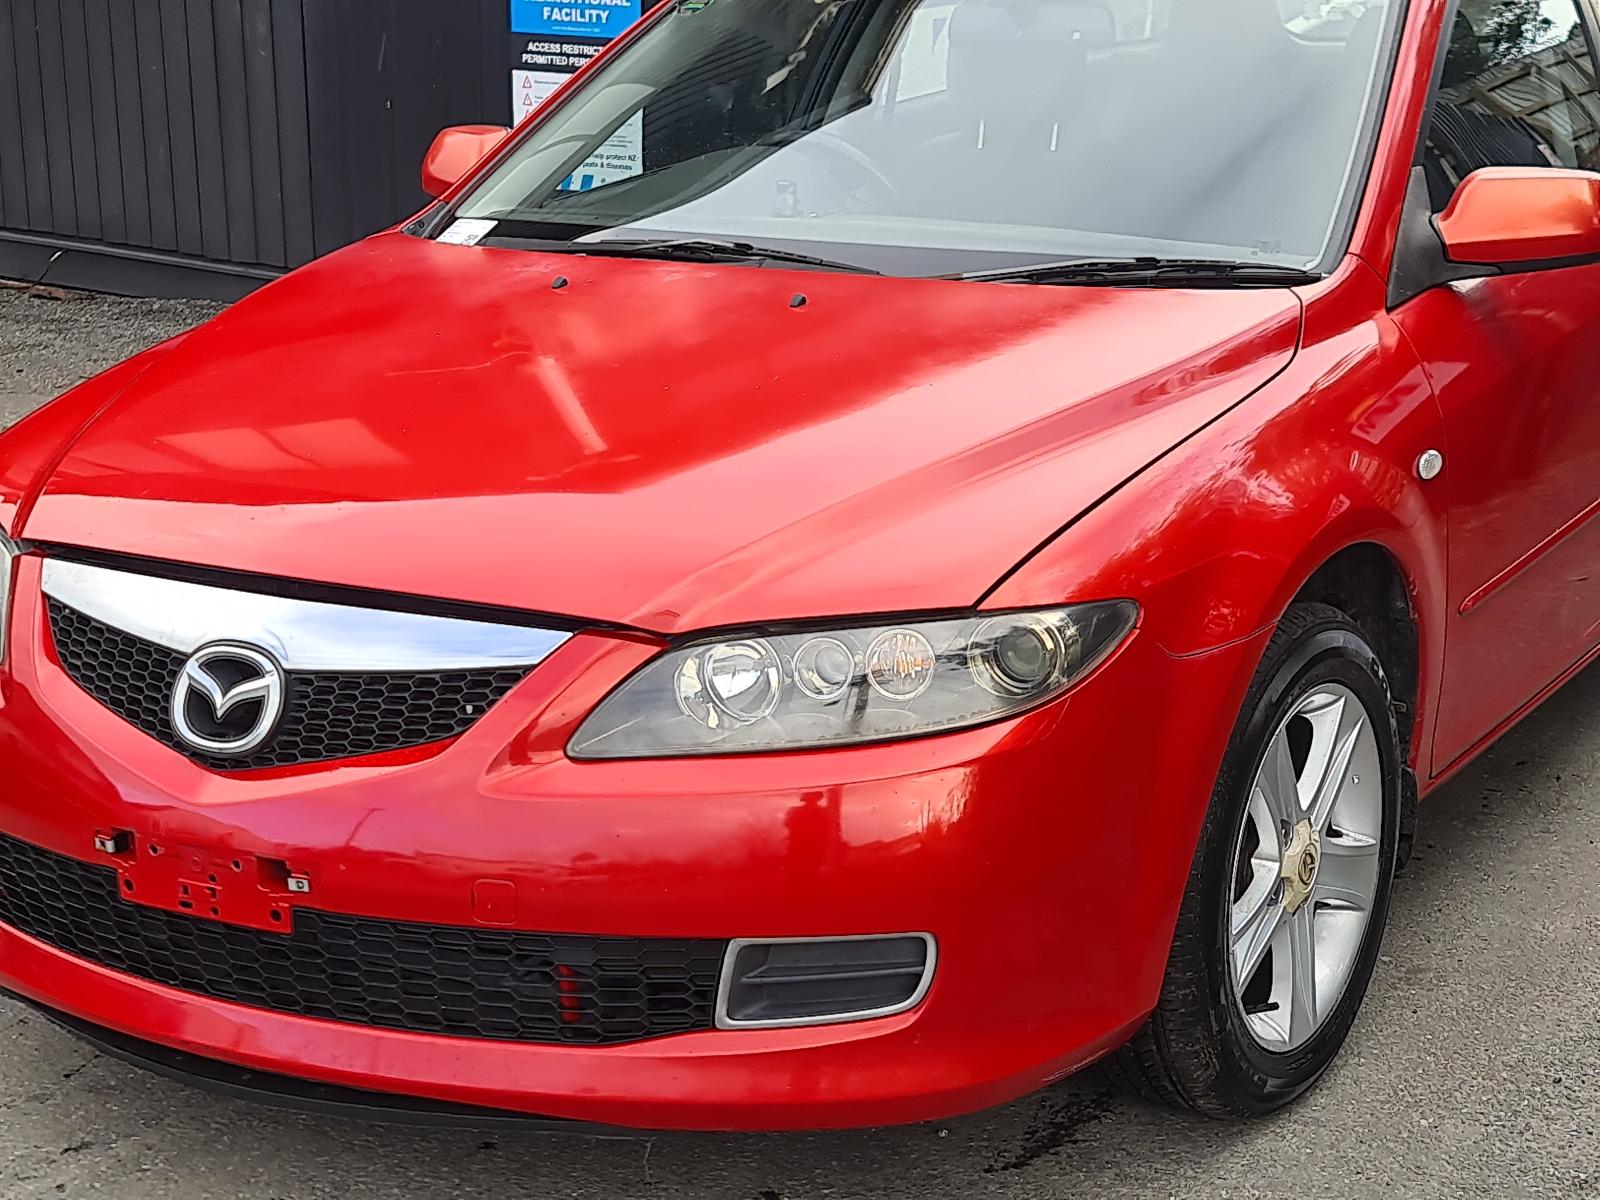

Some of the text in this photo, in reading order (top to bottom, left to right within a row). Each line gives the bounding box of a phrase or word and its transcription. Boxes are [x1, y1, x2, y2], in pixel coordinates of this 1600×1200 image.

[543, 6, 609, 23] FACILITY
[527, 42, 561, 53] ACCESS
[522, 53, 567, 65] PERMITTED
